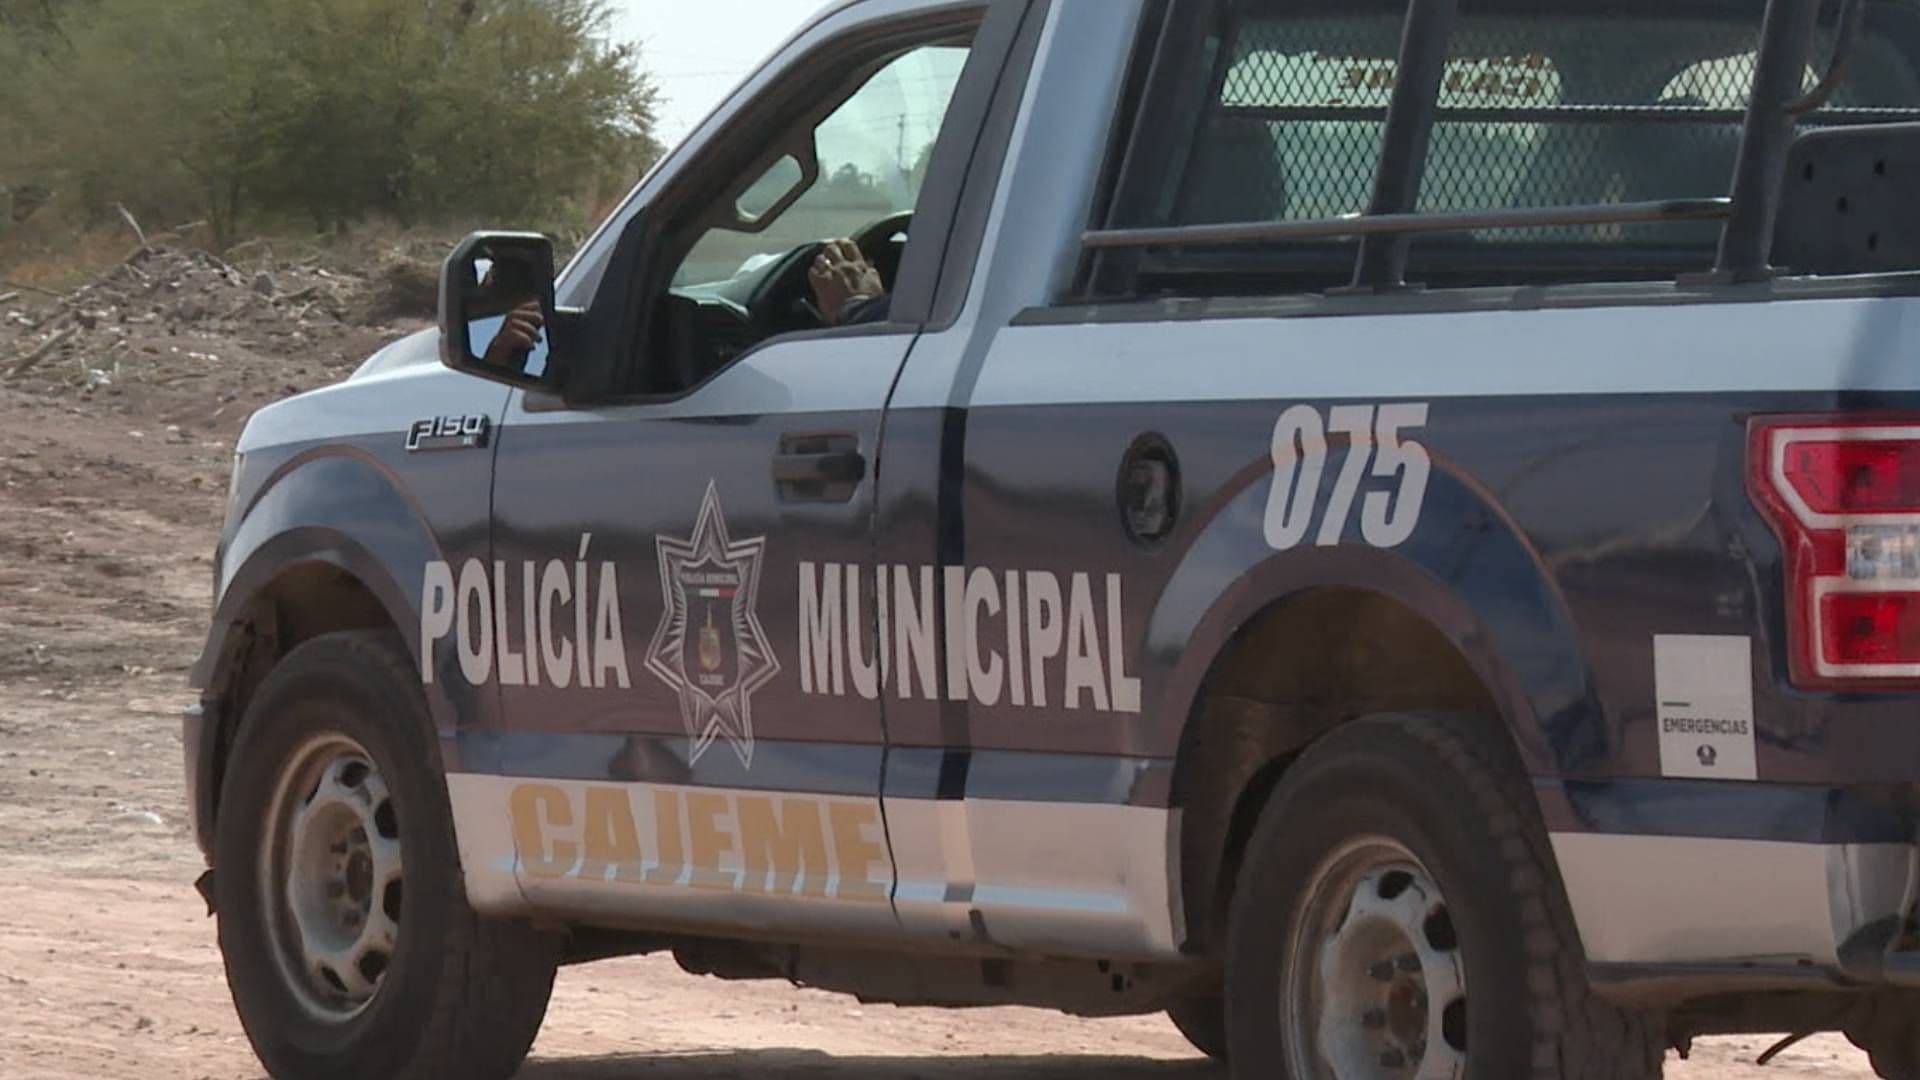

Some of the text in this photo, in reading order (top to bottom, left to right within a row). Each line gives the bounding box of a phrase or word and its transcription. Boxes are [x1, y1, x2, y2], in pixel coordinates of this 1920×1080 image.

[1263, 402, 1431, 550] 075
[421, 532, 1141, 713] POLICÍA MUNICIPAL
[1662, 717, 1748, 735] EMERGENCIAS
[511, 783, 890, 901] CAJEME
